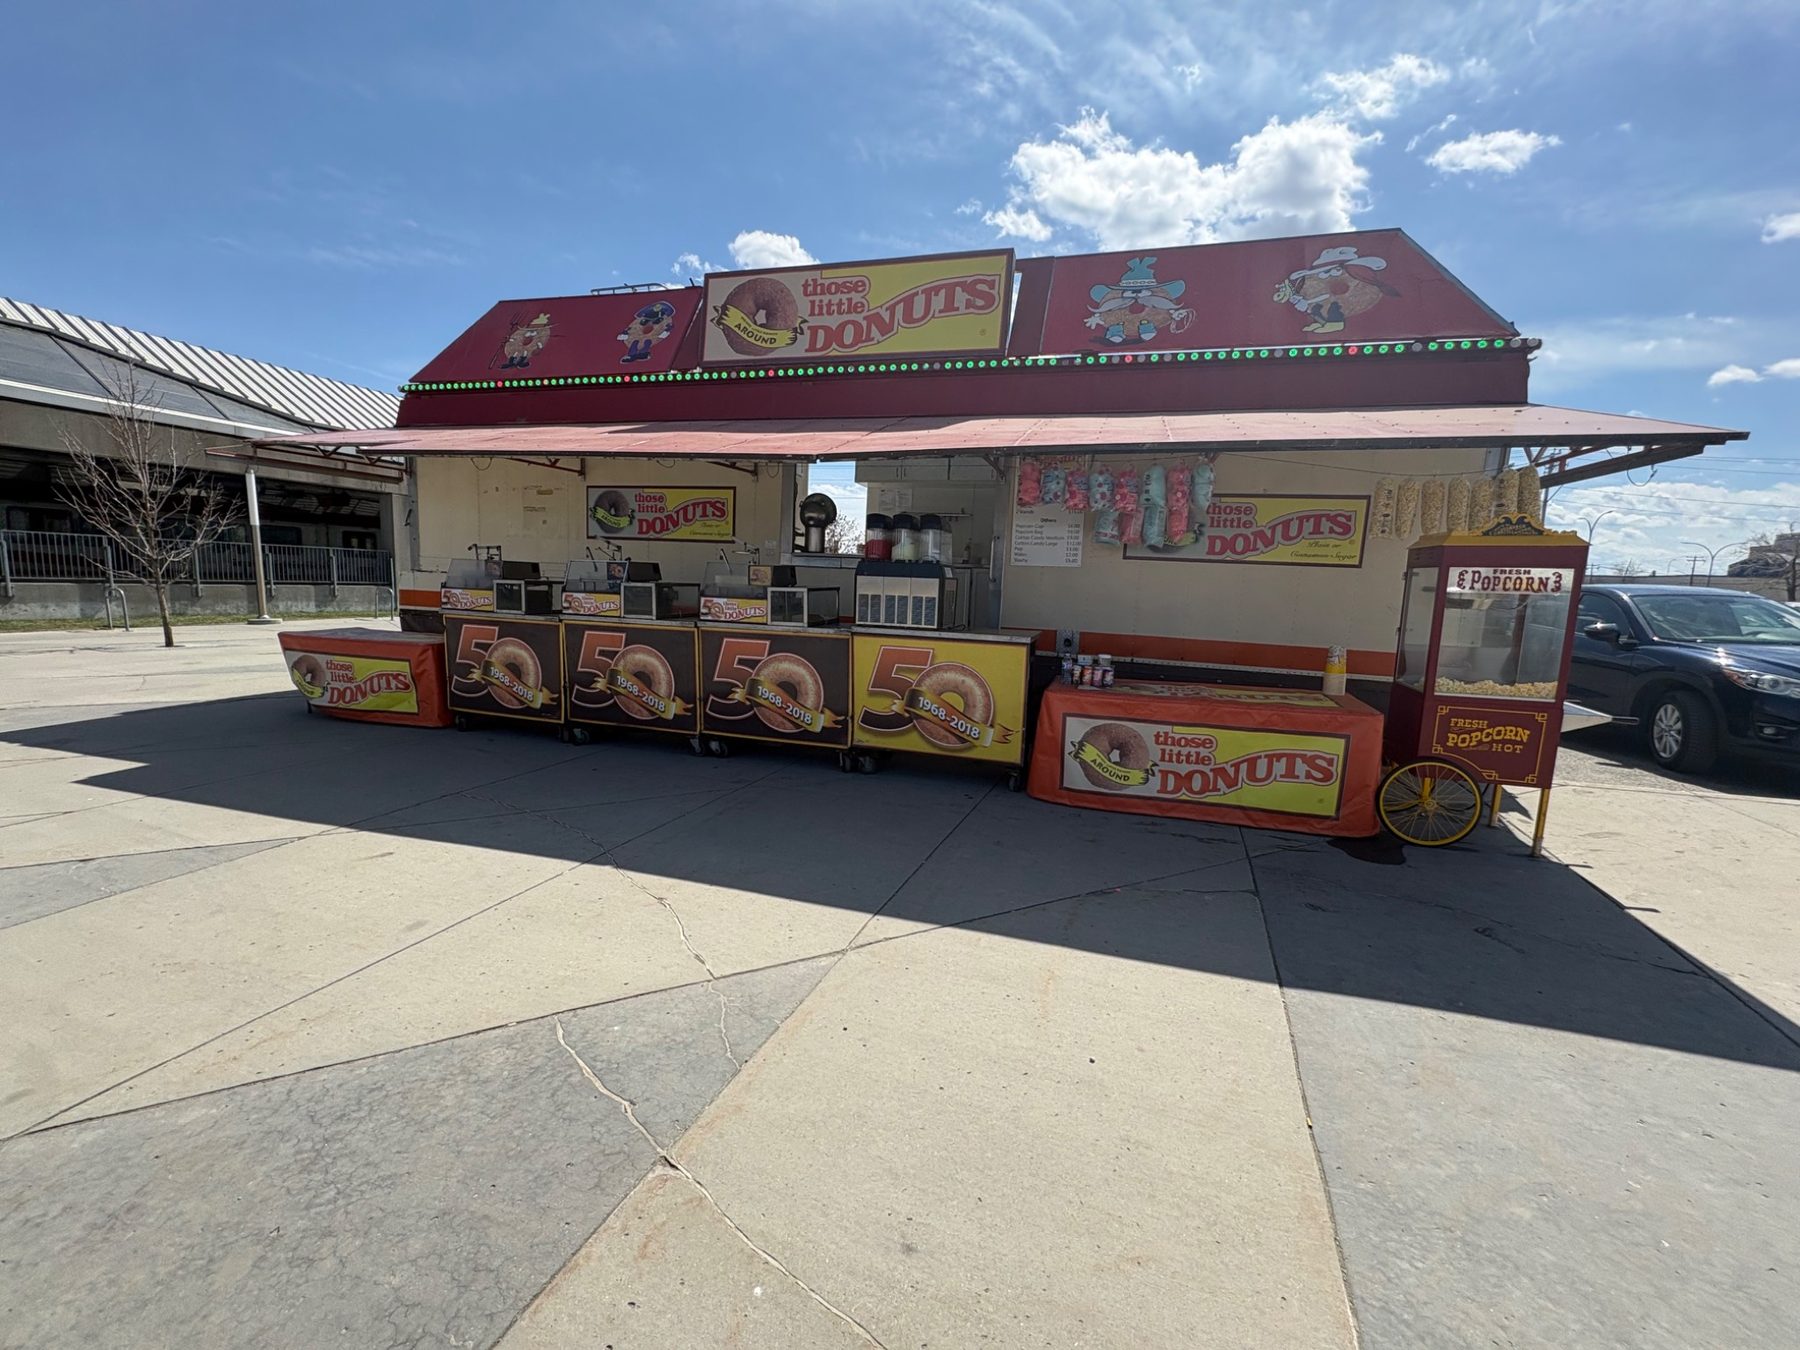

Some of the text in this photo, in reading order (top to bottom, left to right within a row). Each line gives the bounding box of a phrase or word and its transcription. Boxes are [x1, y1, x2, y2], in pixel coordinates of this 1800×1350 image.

[802, 278, 867, 297] those
[804, 278, 996, 353] DONUTS
[808, 298, 866, 317] little
[734, 322, 777, 345] AROUND
[635, 492, 664, 503] those
[637, 503, 665, 513] little
[637, 500, 726, 535] DONUTS
[1208, 516, 1253, 529] little
[1206, 512, 1353, 556] DONUTS
[1469, 570, 1550, 593] POPCORN
[583, 600, 619, 613] DONUTS
[724, 606, 765, 619] DONUTS
[326, 660, 352, 672] those
[331, 672, 354, 683] little
[489, 666, 534, 701] 1968-2018
[328, 673, 411, 704] DONUTS
[616, 675, 666, 712] 1968-2018
[757, 685, 813, 725] 1968-2018
[918, 696, 981, 739] 1968-2018
[1449, 718, 1488, 729] FRESH
[1154, 731, 1214, 748] those
[1446, 726, 1531, 748] POPCORN
[1159, 748, 1213, 766] little
[1491, 743, 1523, 753] HOT
[1091, 759, 1130, 782] AROUND
[1157, 752, 1335, 795] DONUTS
